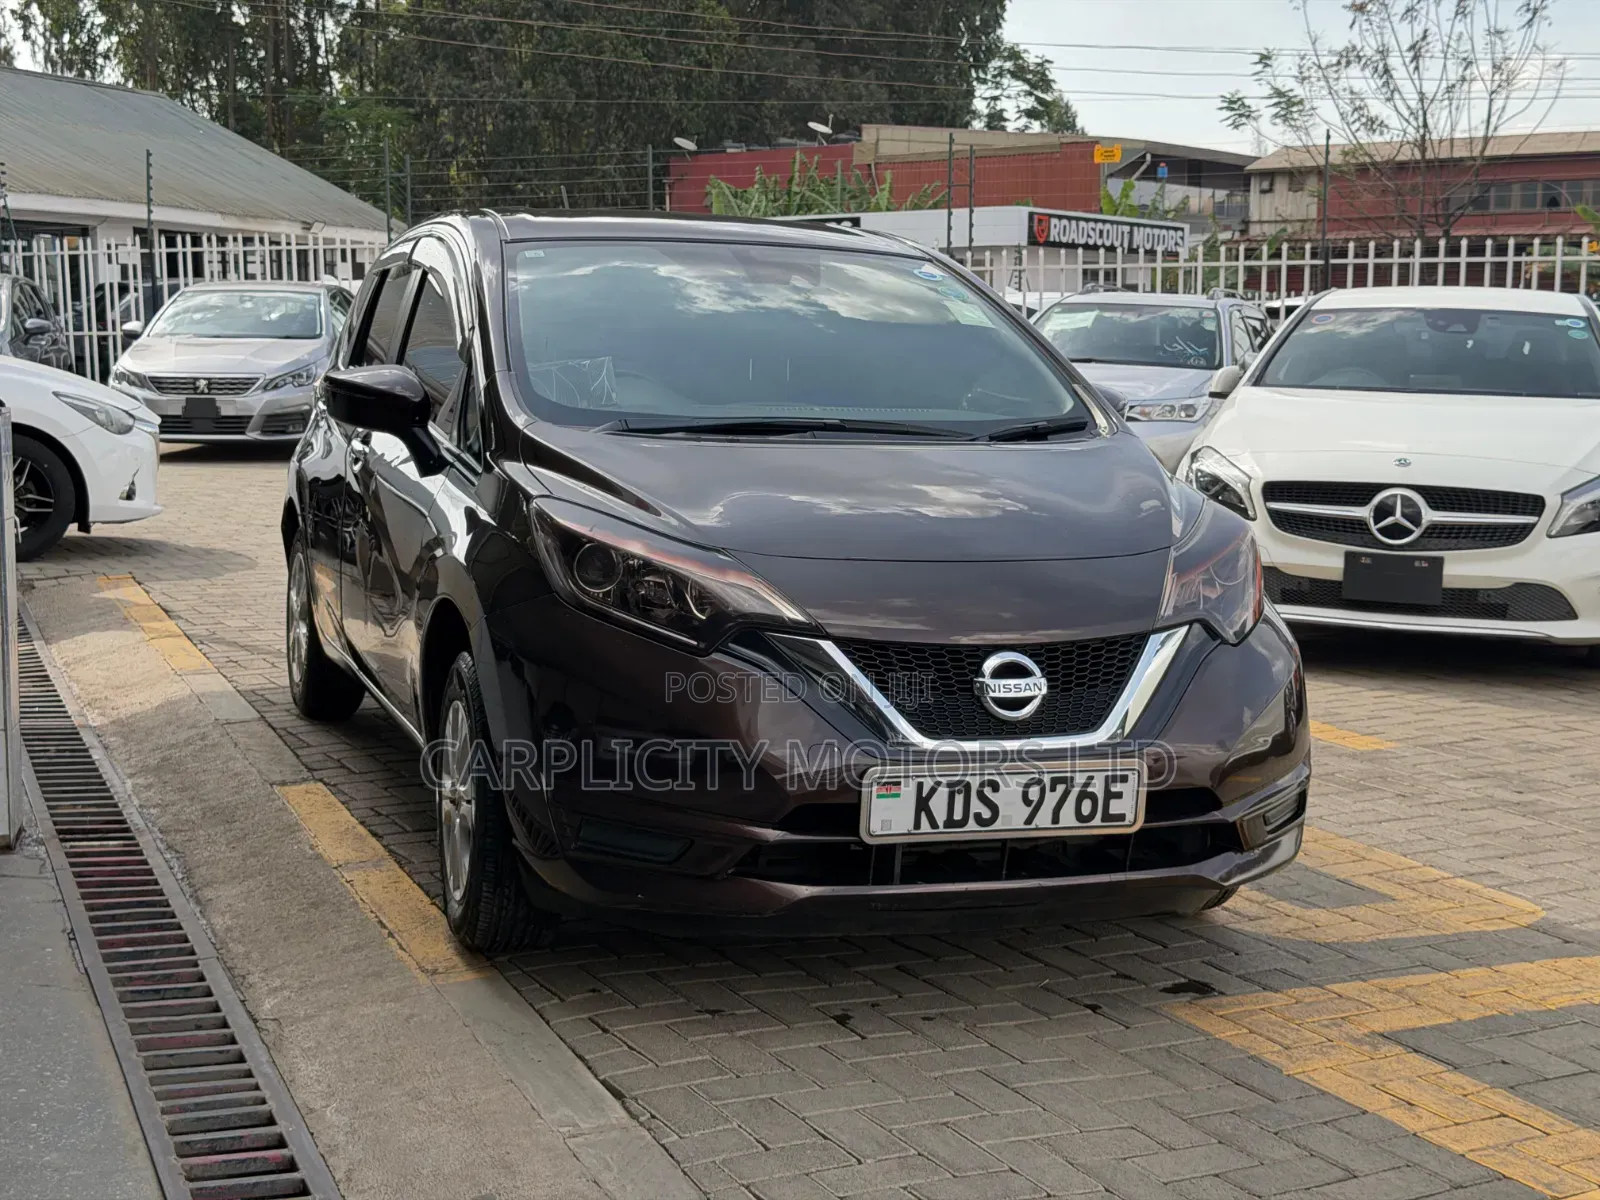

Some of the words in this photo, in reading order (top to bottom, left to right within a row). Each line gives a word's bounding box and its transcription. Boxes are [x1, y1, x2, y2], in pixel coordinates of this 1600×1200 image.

[1050, 217, 1130, 248] ROADSCOUT
[1133, 226, 1184, 252] MOTORS
[985, 682, 1043, 694] NISSAN
[913, 778, 1000, 830] KDS
[1021, 773, 1129, 826] 976E
